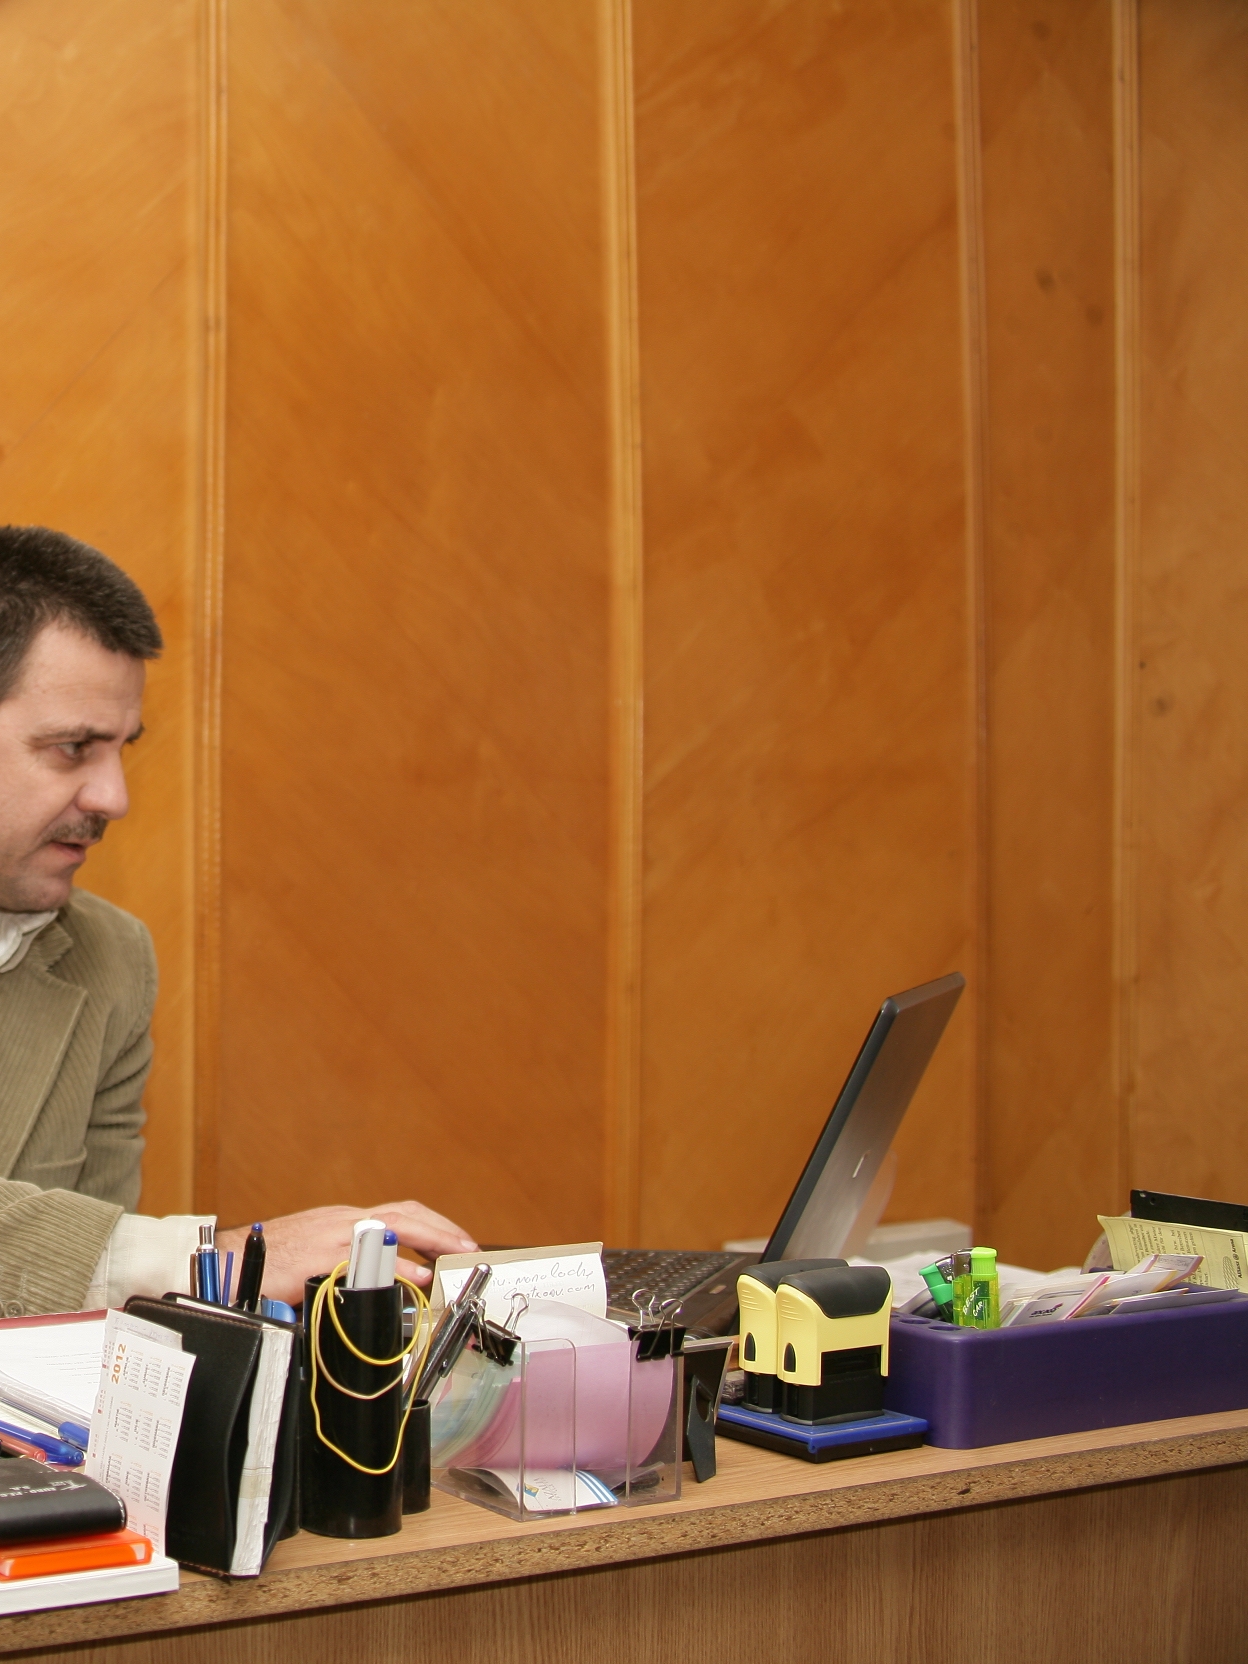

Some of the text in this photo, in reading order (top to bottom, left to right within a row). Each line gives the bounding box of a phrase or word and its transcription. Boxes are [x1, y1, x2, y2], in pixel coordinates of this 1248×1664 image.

[963, 1286, 981, 1315] BEST
[973, 1301, 983, 1317] CAR
[112, 1343, 127, 1385] 2012
